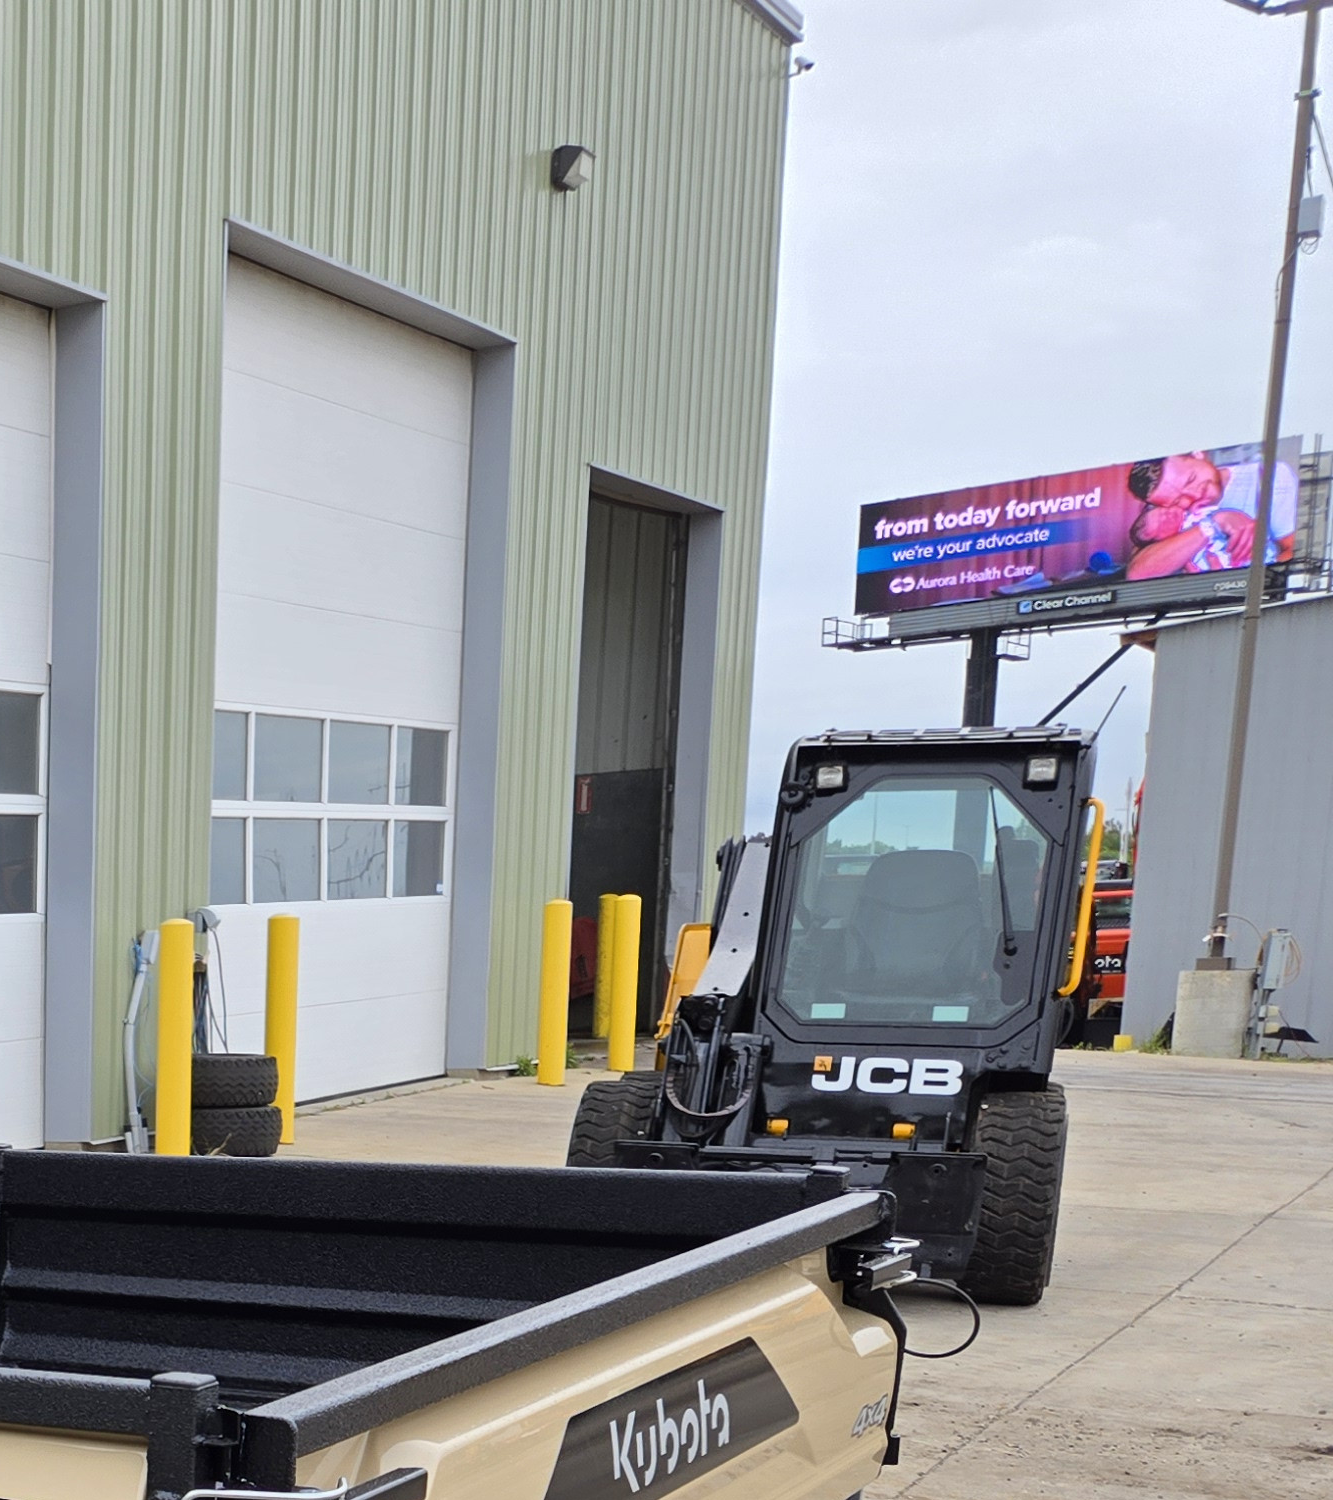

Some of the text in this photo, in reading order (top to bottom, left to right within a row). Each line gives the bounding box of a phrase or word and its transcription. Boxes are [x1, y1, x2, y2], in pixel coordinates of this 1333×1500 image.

[875, 487, 1101, 540] from today forward
[892, 529, 1049, 562] we're your advocate
[917, 565, 1035, 590] Aurora Health Care
[1034, 592, 1112, 611] Clear Channel
[1095, 956, 1122, 967] ota
[811, 1056, 963, 1095] JCB
[851, 1393, 888, 1438] 4x4
[609, 1379, 730, 1493] Kubota
